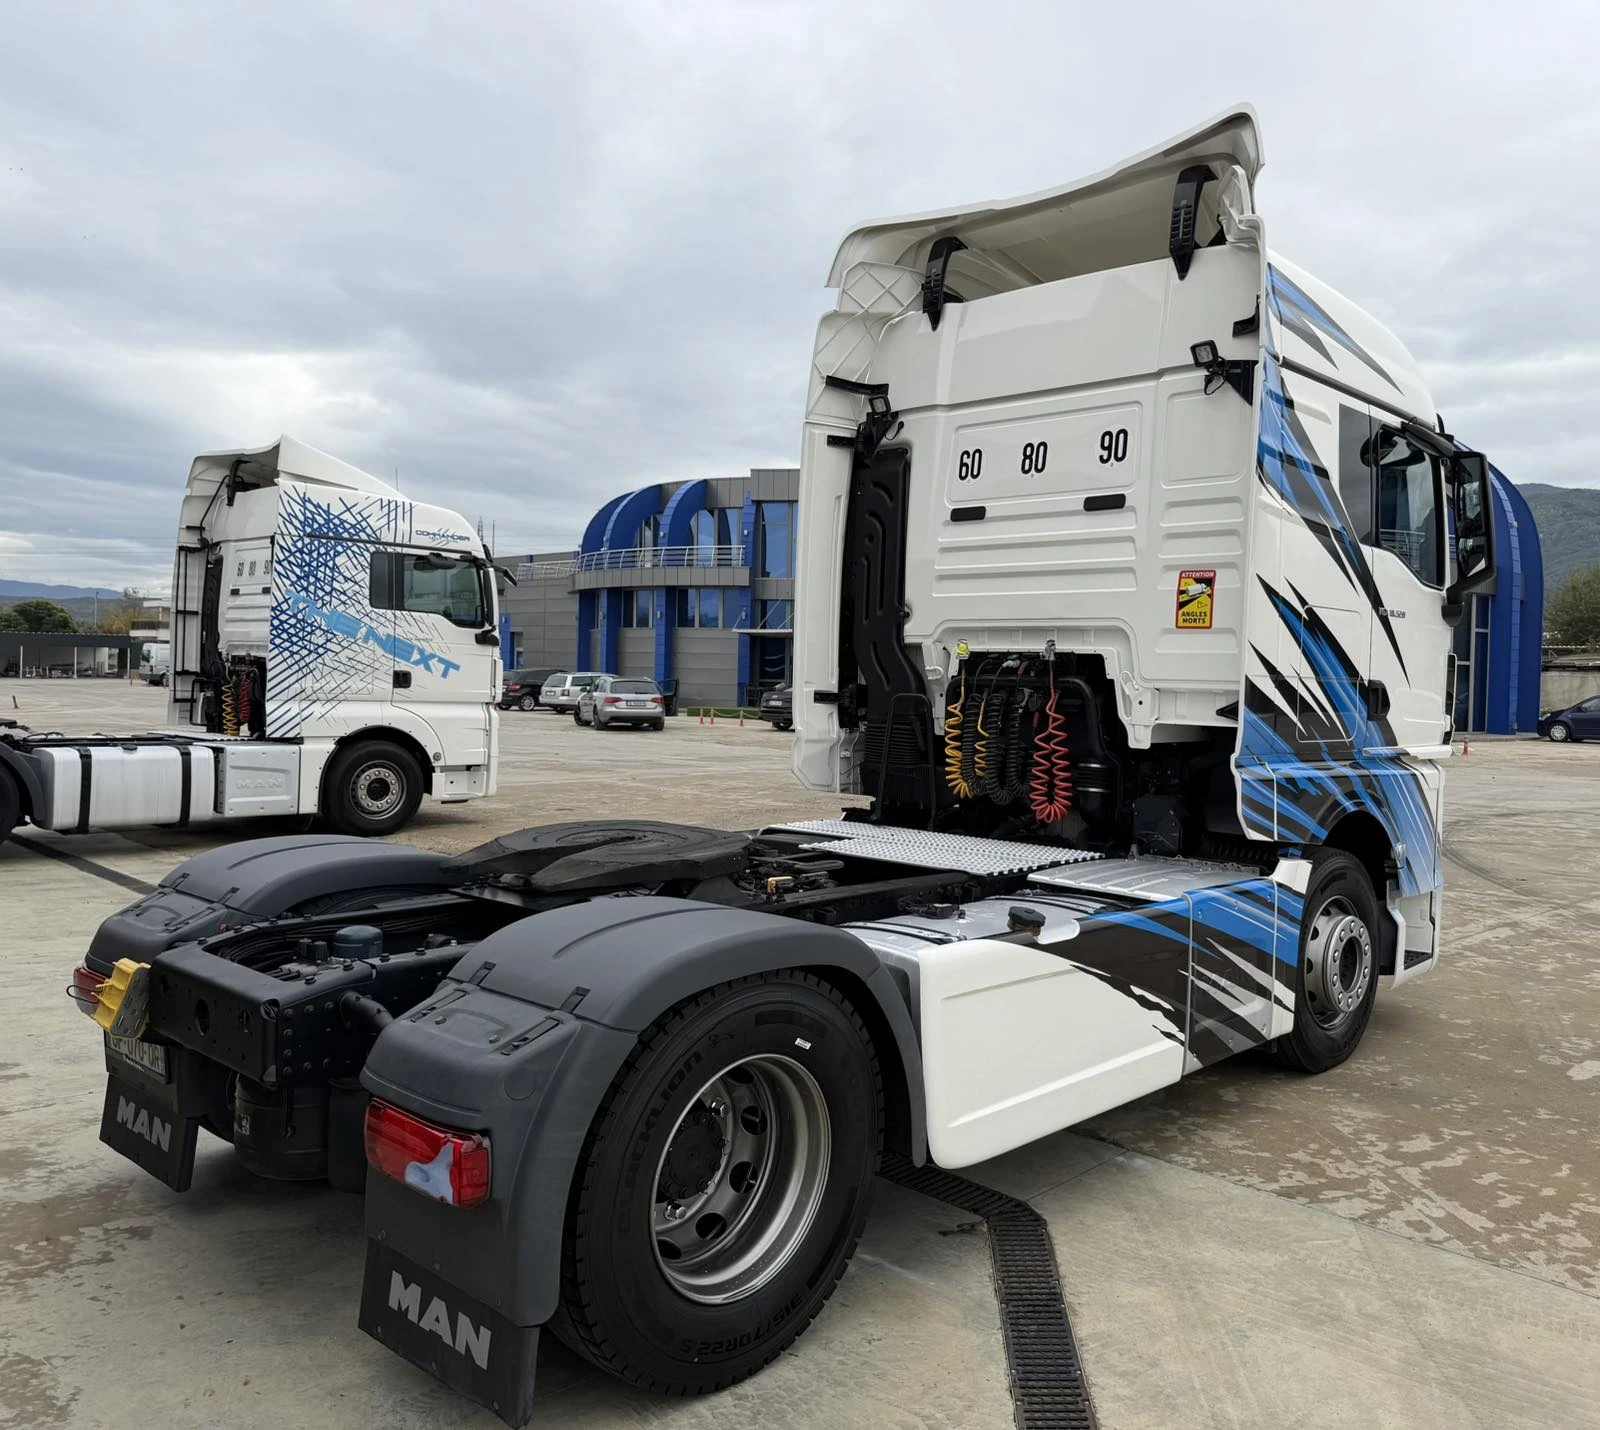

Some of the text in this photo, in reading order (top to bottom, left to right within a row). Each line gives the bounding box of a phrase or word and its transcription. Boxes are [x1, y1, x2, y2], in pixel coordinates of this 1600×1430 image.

[1021, 441, 1048, 475] 80
[1099, 428, 1128, 464] 90
[958, 448, 983, 481] 60
[415, 530, 470, 541] COMMANDER
[284, 589, 461, 679] THE NEXT
[116, 1095, 171, 1153] MAN
[388, 1269, 492, 1371] MAN
